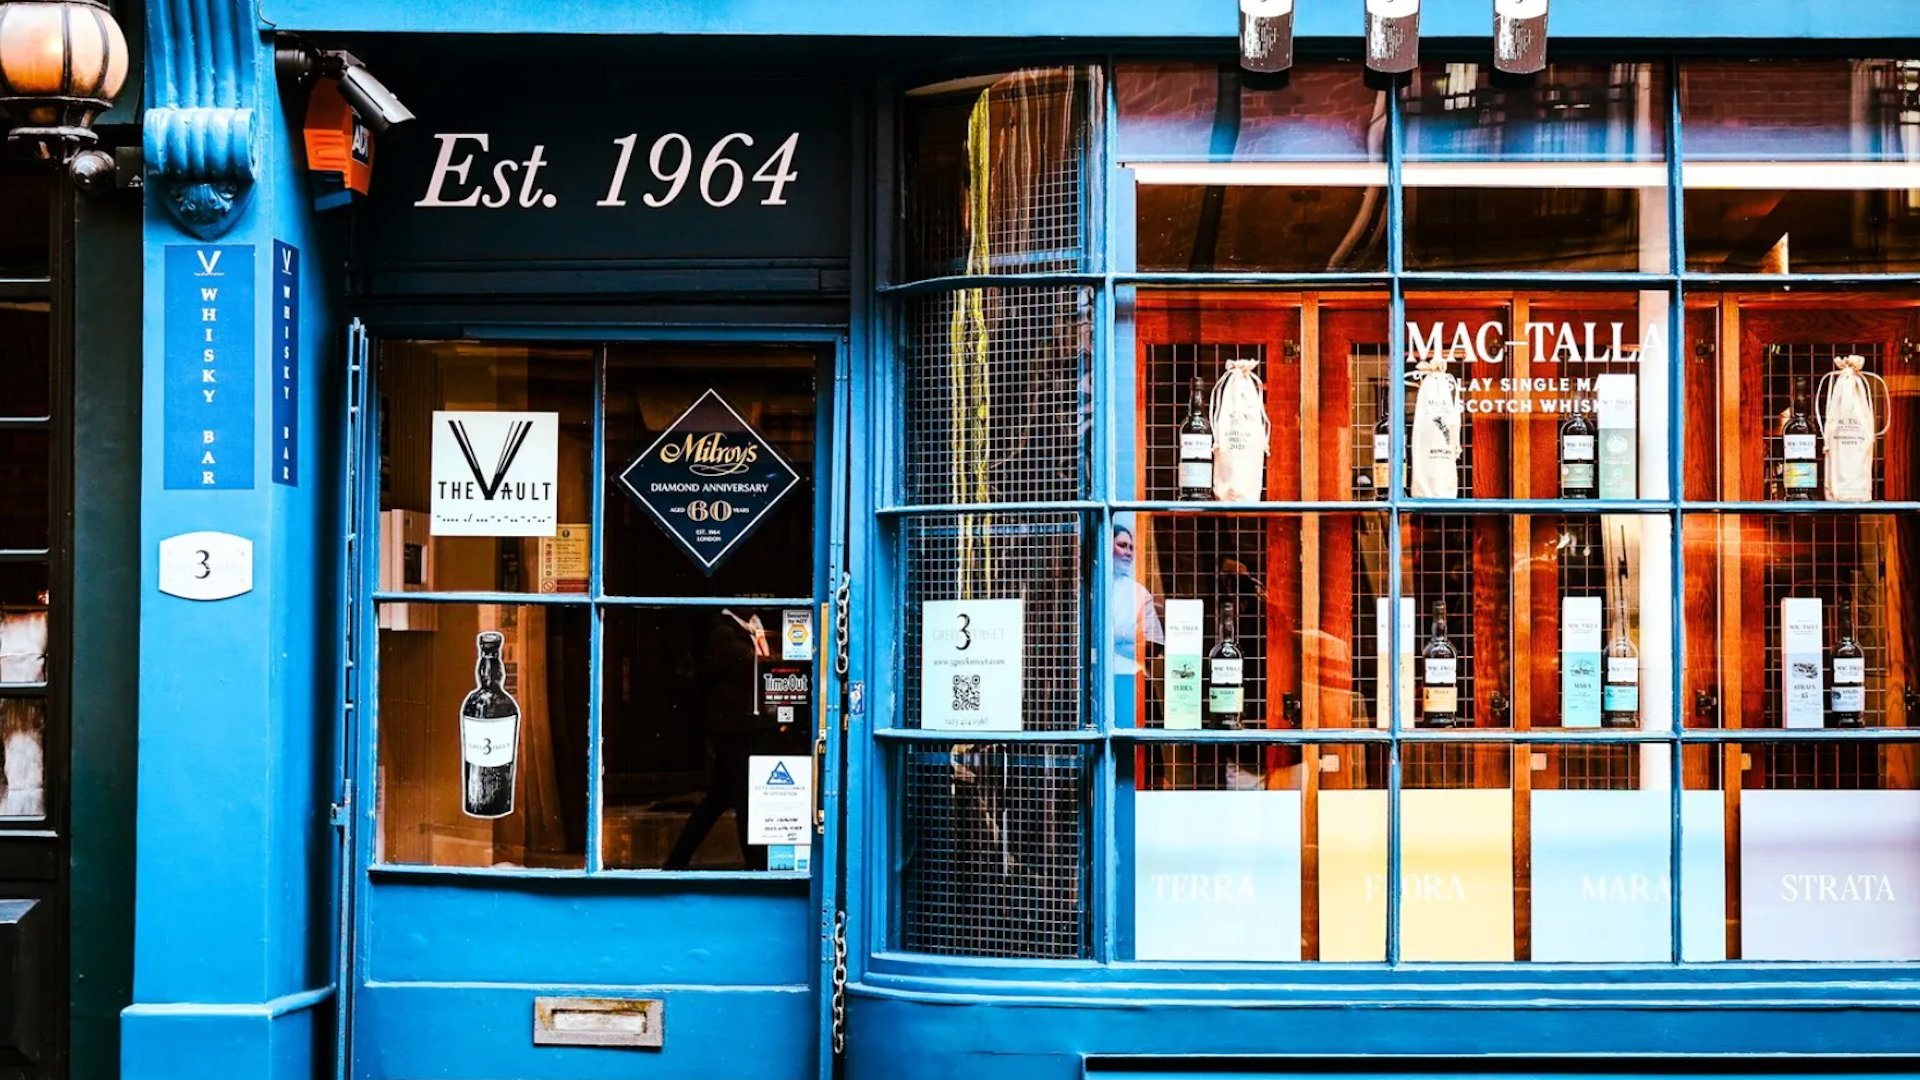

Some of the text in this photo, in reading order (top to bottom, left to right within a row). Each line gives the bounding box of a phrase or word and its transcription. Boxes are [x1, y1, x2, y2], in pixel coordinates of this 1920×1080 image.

[413, 132, 800, 208] Est. 1964
[283, 285, 291, 400] WHISKY
[201, 288, 218, 485] WHISKY BAR
[1447, 378, 1493, 392] SLAY
[1500, 378, 1570, 392] SINGLE
[1455, 399, 1532, 413] SCOTCH
[659, 432, 759, 477] Milroy's
[438, 481, 474, 500] THE
[651, 483, 769, 493] DIAMOND ANNIVERSARY
[687, 500, 732, 522] 60
[195, 549, 211, 579] 3
[956, 613, 971, 651] 3
[483, 738, 492, 755] 3
[1152, 874, 1256, 901] TERRA
[1365, 874, 1466, 901] FORA
[1581, 874, 1671, 901] MARA
[1780, 873, 1896, 901] STRATA
